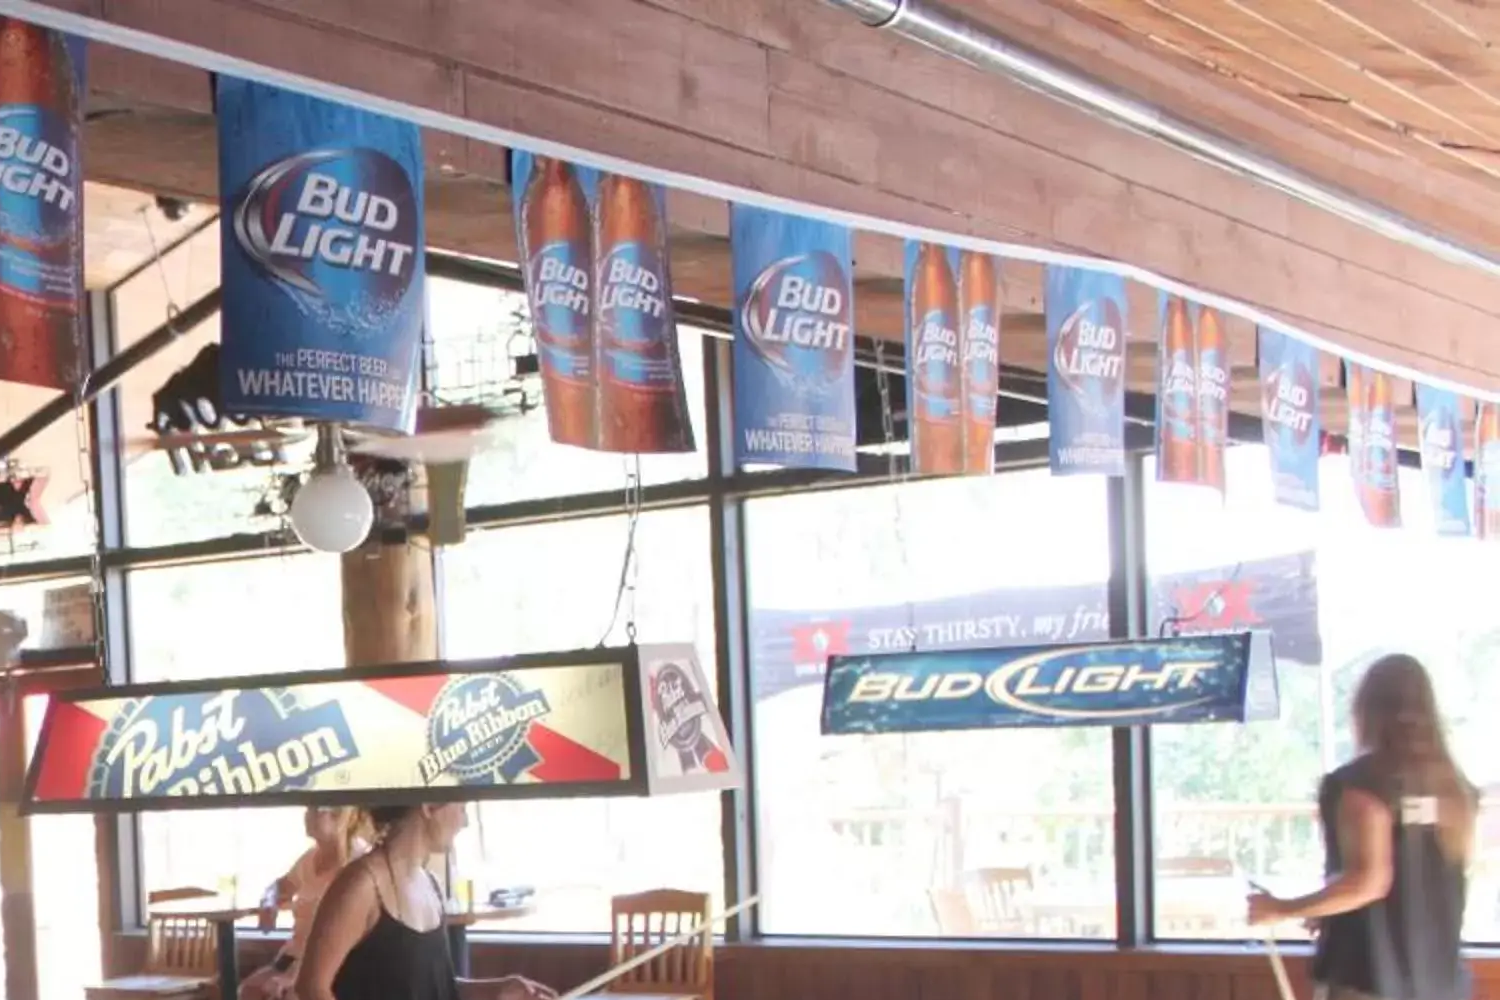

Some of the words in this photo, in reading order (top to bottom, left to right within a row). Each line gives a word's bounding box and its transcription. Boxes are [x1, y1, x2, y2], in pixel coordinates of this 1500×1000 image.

[297, 172, 398, 232] BUD
[269, 212, 414, 276] LIGHT
[540, 256, 589, 291] BUD
[609, 258, 659, 293] BUD
[600, 284, 665, 318] LIGHT
[777, 275, 842, 316] BUD
[763, 307, 850, 351] LIGHT
[922, 321, 956, 346] BUD
[1077, 318, 1117, 350] BUD
[275, 352, 297, 368] THE
[297, 349, 358, 373] PERFECT
[359, 356, 387, 377] BEER
[1069, 348, 1123, 379] LIGHT
[237, 368, 355, 402] WHATEVER
[357, 378, 408, 411] HAPPE
[1277, 372, 1308, 408] BUD
[1270, 397, 1313, 431] LIGHT
[744, 428, 813, 454] WHATEVER
[867, 627, 918, 650] STAY
[921, 614, 1028, 645] THIRSTY,
[1032, 614, 1067, 641] my
[848, 671, 982, 704] BUD
[1011, 660, 1219, 697] LIGHT
[439, 680, 501, 737] Pabst
[106, 689, 246, 798] Pabst
[419, 737, 469, 782] Blue
[466, 699, 546, 748] Ribbon
